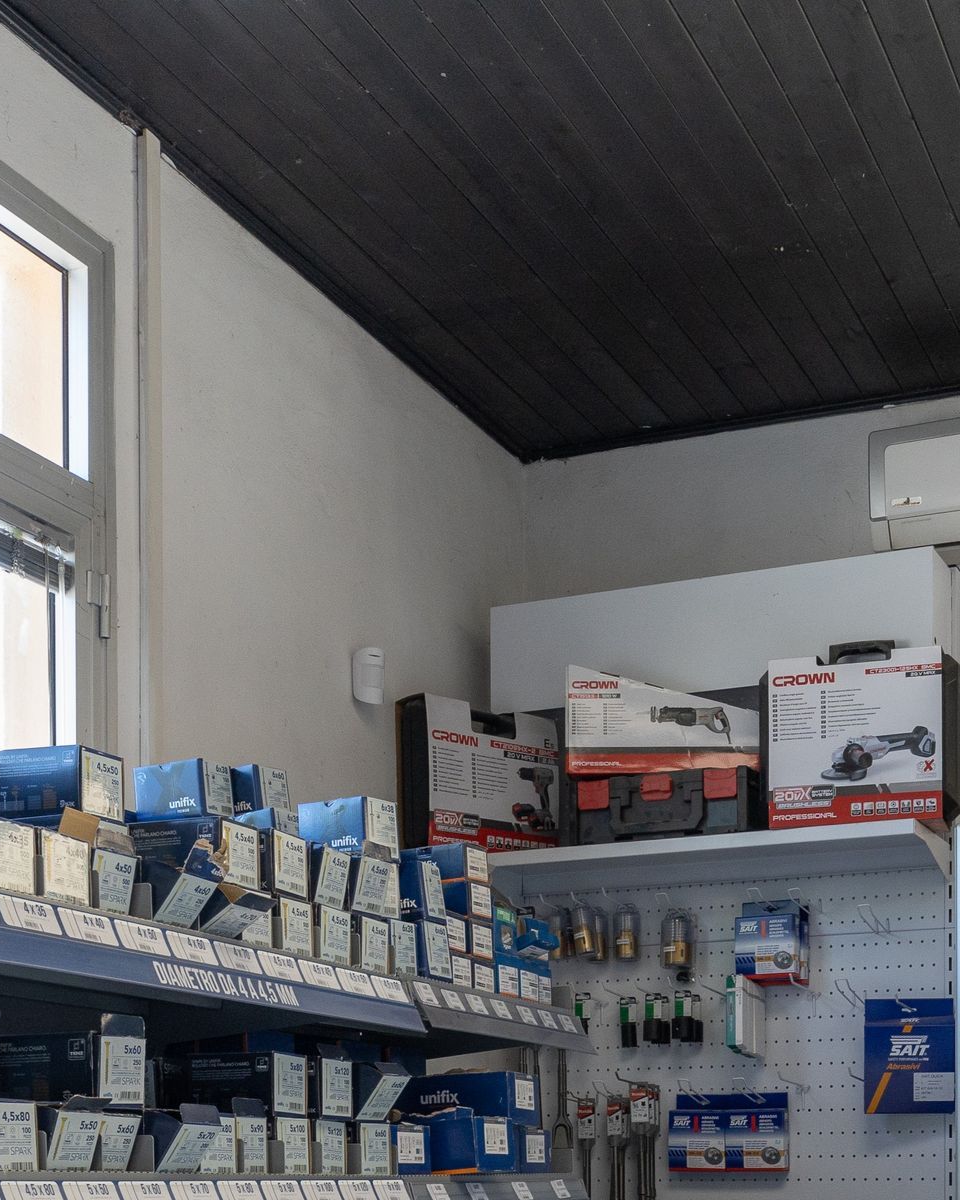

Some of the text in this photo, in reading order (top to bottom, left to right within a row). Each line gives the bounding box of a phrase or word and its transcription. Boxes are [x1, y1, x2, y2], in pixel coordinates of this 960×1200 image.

[572, 681, 618, 689] CROWN
[773, 672, 835, 687] CROWN
[432, 729, 478, 747] CROWN
[96, 762, 118, 776] 4,5x50
[169, 797, 196, 809] unifix
[773, 813, 837, 821] PROFESSIONAL
[332, 836, 358, 847] unifix
[152, 961, 220, 994] DIAMETRO
[221, 977, 239, 996] DA
[258, 982, 276, 1002] 4,5
[277, 986, 299, 1006] MM
[886, 1063, 920, 1071] Abrasivi
[420, 1091, 459, 1105] unifix
[2, 1111, 30, 1122] 4,5x80
